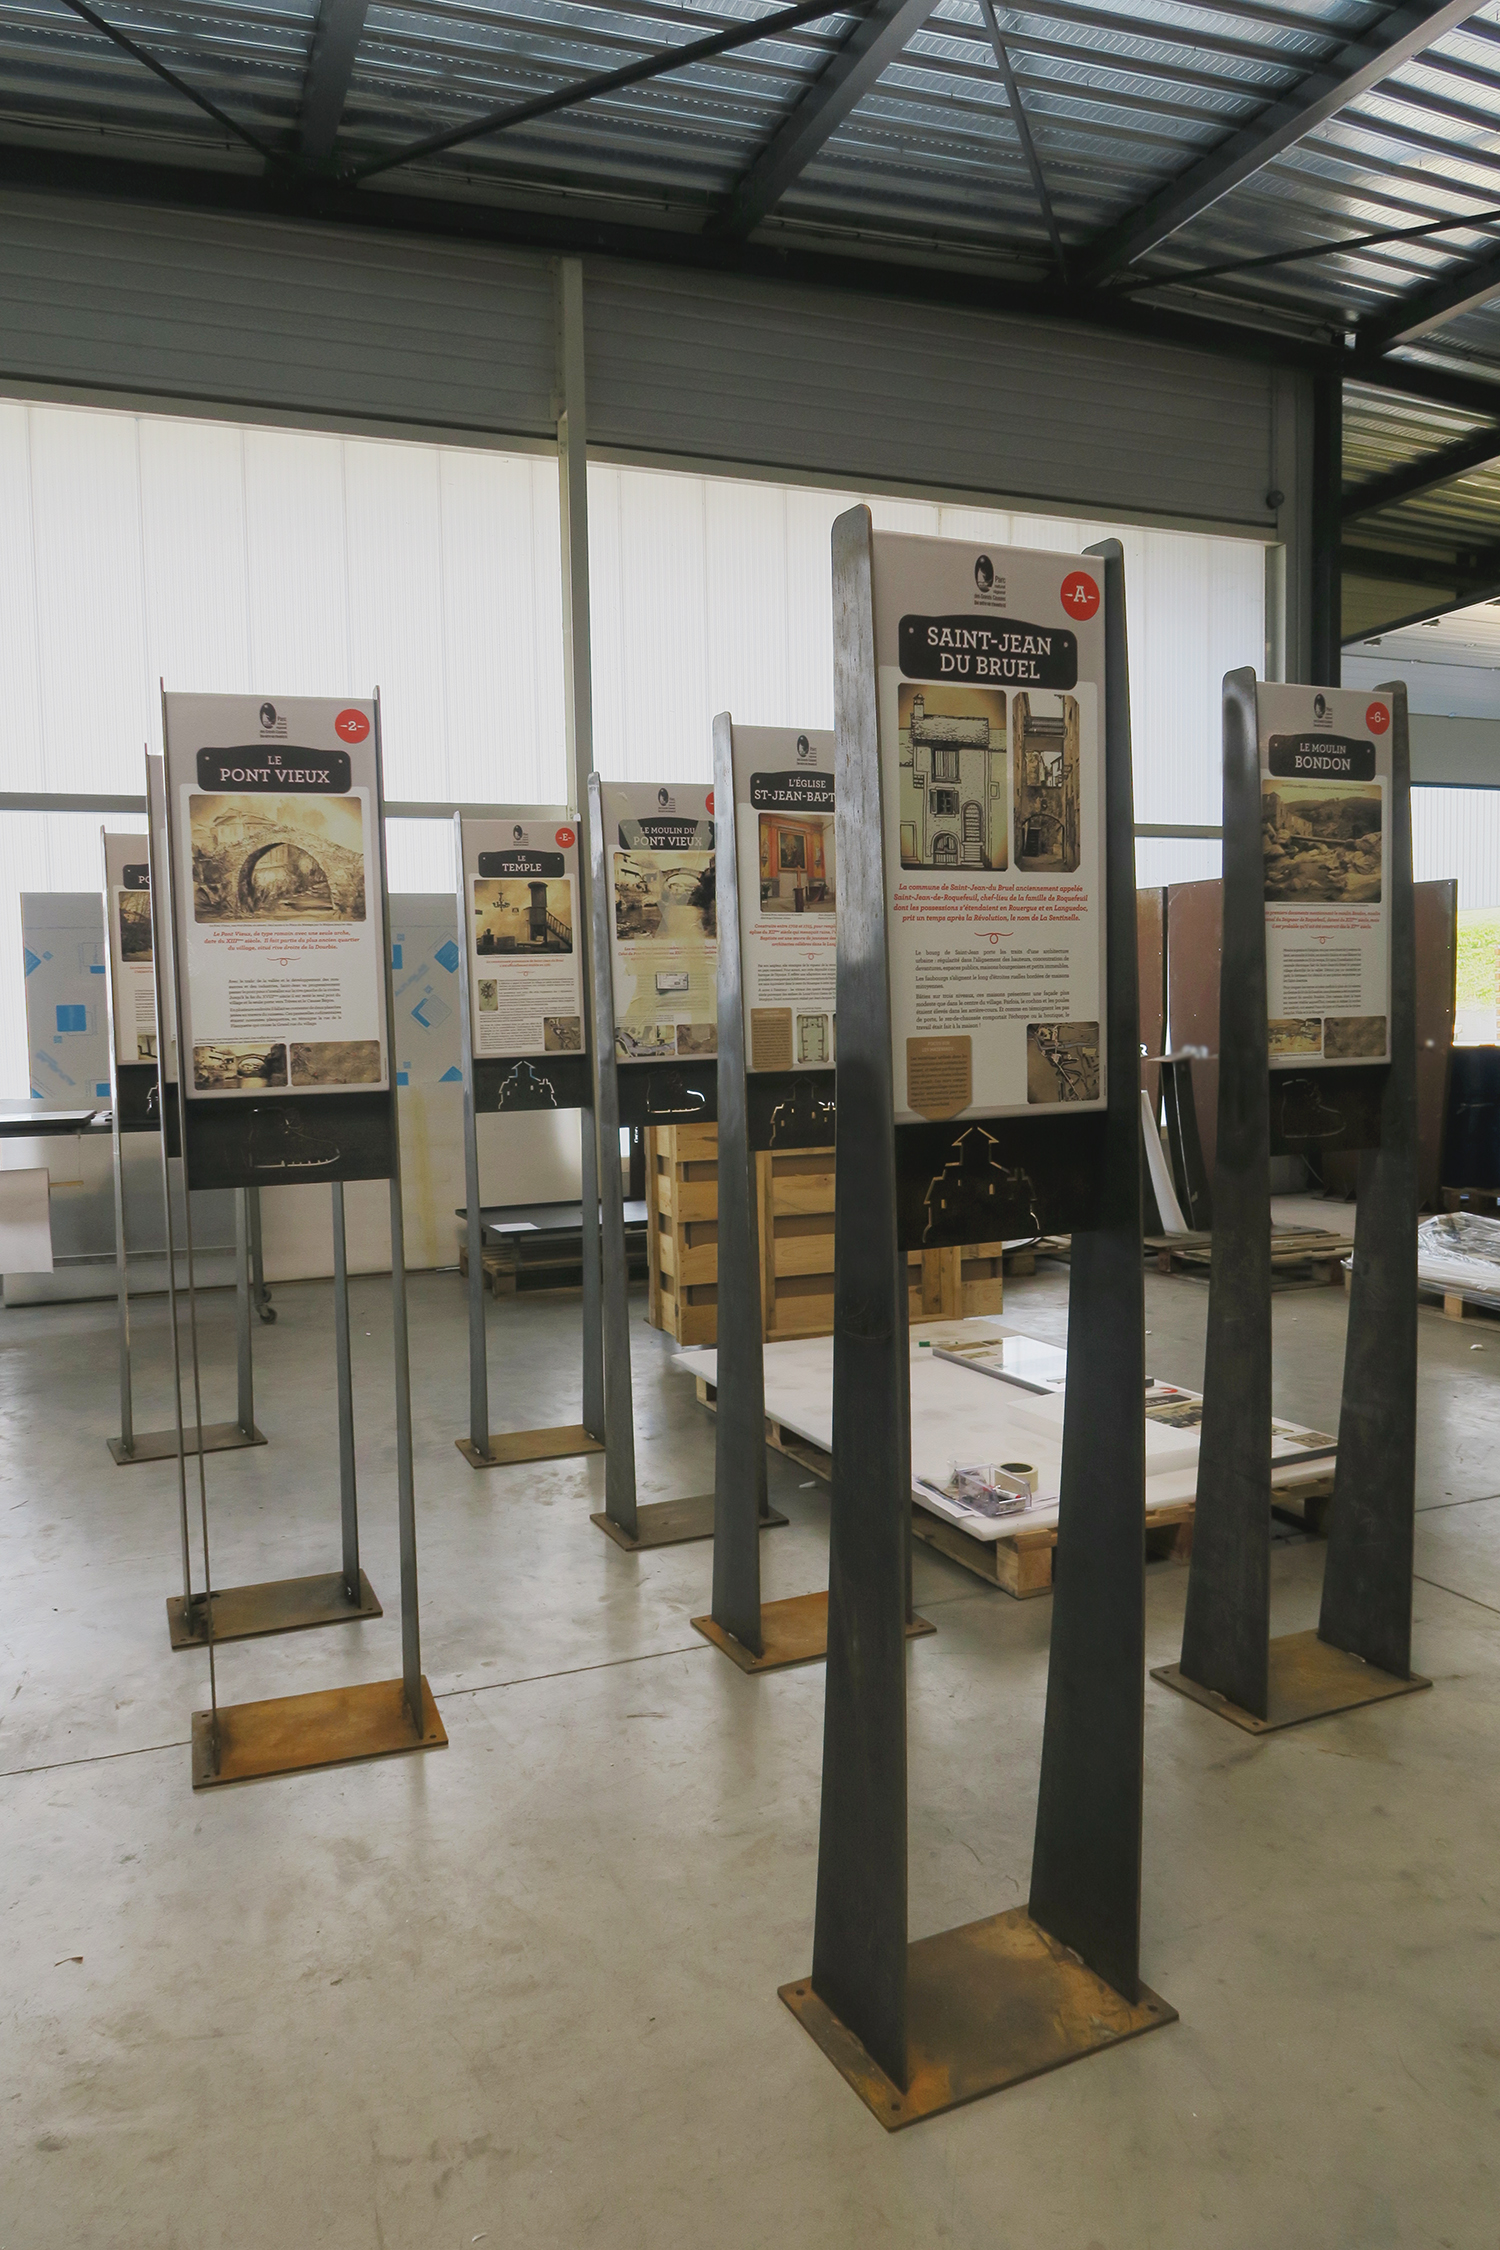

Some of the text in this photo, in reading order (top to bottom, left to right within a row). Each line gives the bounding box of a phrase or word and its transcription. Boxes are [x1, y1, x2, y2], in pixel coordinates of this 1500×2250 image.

[927, 626, 1051, 655] SAINT-JEAN
[940, 653, 1040, 679] DU BRUEL
[1300, 742, 1346, 754] LE MOULIN
[268, 755, 282, 765] LE
[1295, 756, 1351, 770] BONDON
[220, 768, 330, 783] PONT VIEUX
[789, 777, 826, 788] L'ÉGLISE
[633, 836, 702, 847] PONT VIEUX
[502, 863, 541, 871] TEMPLE
[1060, 885, 1083, 893] appelée
